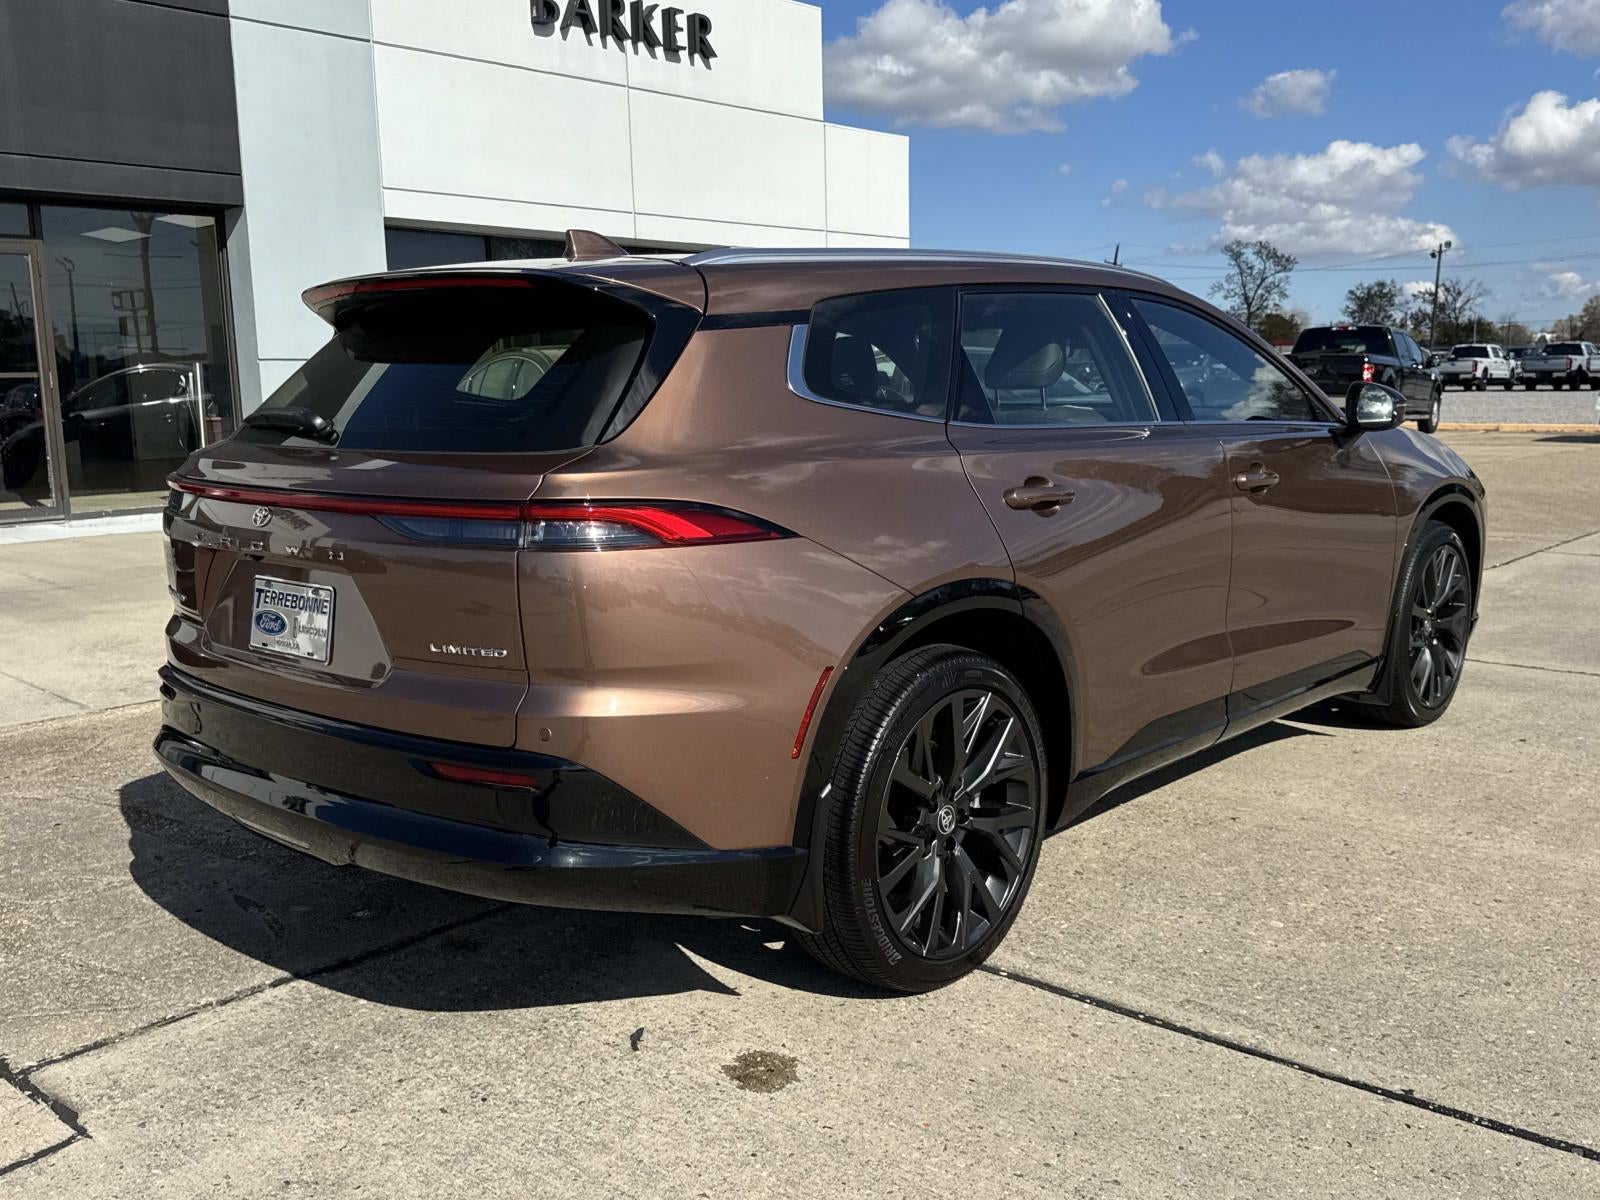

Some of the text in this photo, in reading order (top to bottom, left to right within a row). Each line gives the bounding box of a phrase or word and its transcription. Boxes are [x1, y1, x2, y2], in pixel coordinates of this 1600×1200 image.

[255, 587, 329, 615] TERREBONNE
[429, 643, 508, 657] LIMITED
[863, 879, 903, 966] BRIDGESTONE
